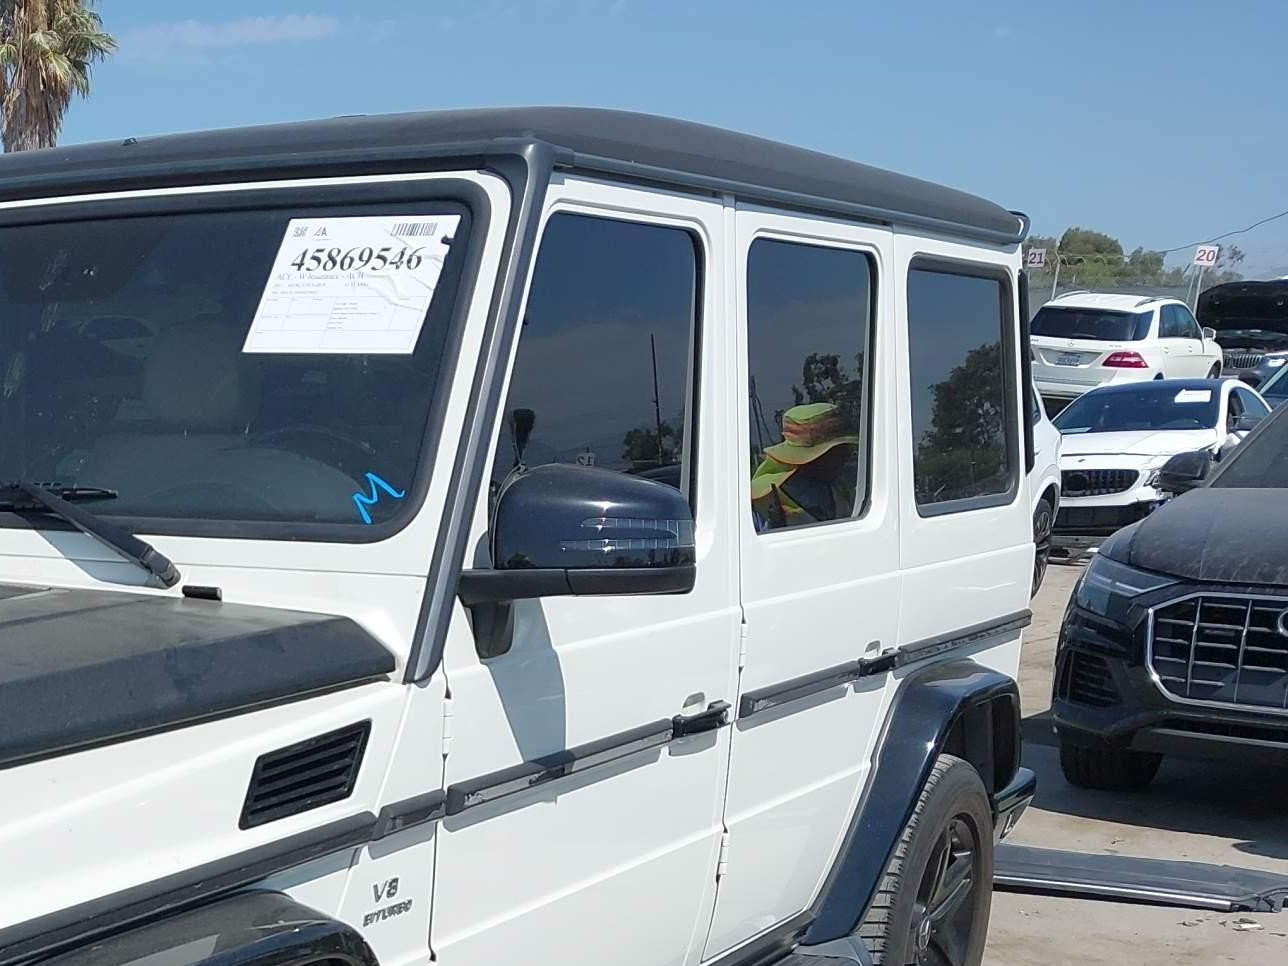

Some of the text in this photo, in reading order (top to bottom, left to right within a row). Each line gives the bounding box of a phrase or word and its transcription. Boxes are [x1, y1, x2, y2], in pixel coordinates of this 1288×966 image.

[290, 246, 427, 272] 45869546
[1029, 252, 1044, 264] 21
[1196, 249, 1216, 262] 20
[373, 877, 399, 903] V8
[362, 899, 413, 928] BITURBO
